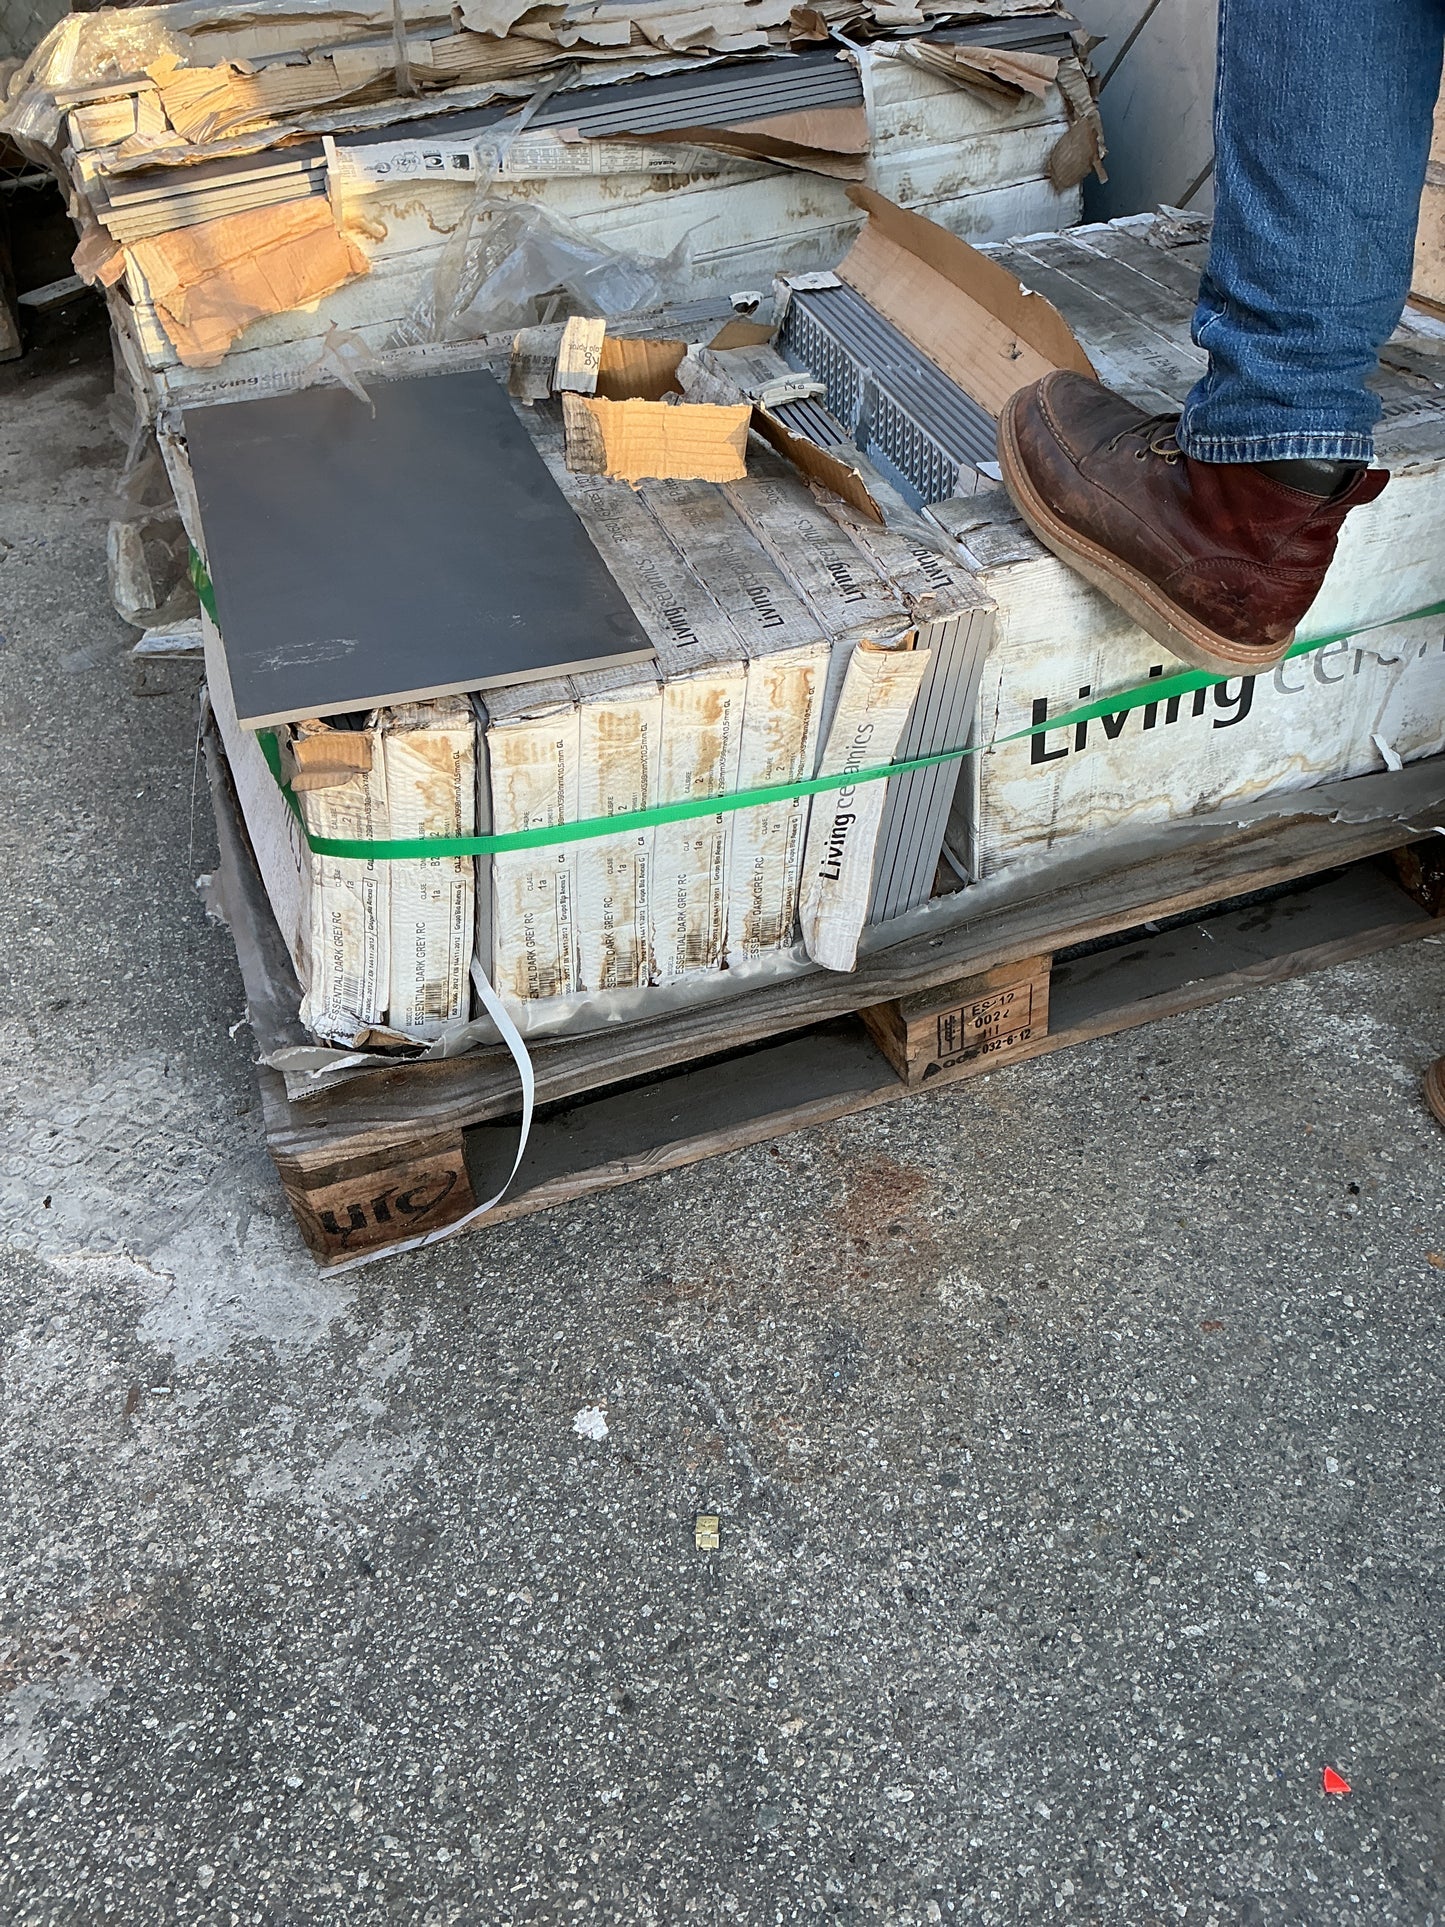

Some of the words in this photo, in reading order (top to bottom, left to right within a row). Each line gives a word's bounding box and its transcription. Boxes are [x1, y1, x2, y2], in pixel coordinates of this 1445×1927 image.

[584, 352, 599, 370] Kg
[793, 518, 840, 562] ceramics
[636, 558, 677, 610] ceramics
[826, 561, 867, 604] Living
[746, 586, 785, 629] Living
[663, 606, 699, 649] Living
[808, 686, 815, 694] GL
[724, 699, 730, 708] GL
[641, 723, 647, 731] GL
[556, 740, 563, 748] GL
[454, 750, 460, 759] GL
[836, 723, 874, 809] ceamics
[772, 824, 780, 833] 1a
[694, 841, 703, 850] 1a
[818, 814, 855, 880] Living
[617, 864, 626, 873] 1a
[755, 857, 764, 868] RC
[537, 880, 547, 889] 1a
[678, 874, 686, 884] RC
[754, 871, 763, 894] GREY
[431, 890, 440, 899] 1a
[604, 897, 612, 908] RC
[678, 888, 686, 908] GREY
[753, 895, 762, 915] DARK
[332, 912, 342, 924] RC
[416, 922, 425, 932] RC
[524, 912, 533, 923] RC
[604, 910, 613, 930] GREY
[677, 911, 686, 932] DARK
[333, 925, 343, 947] GREY
[525, 926, 535, 947] GREY
[605, 932, 615, 955] DARK
[750, 919, 761, 959] ESSENTIAL
[416, 936, 426, 958] GREY
[675, 934, 686, 974] ESSENTIAL
[334, 949, 343, 972] DARK
[527, 950, 536, 970] DARK
[416, 961, 425, 981] DARK
[607, 957, 616, 987] SENTIAL
[328, 975, 343, 1020] ESSENTIAL
[415, 984, 424, 1025] ESSENTIAL
